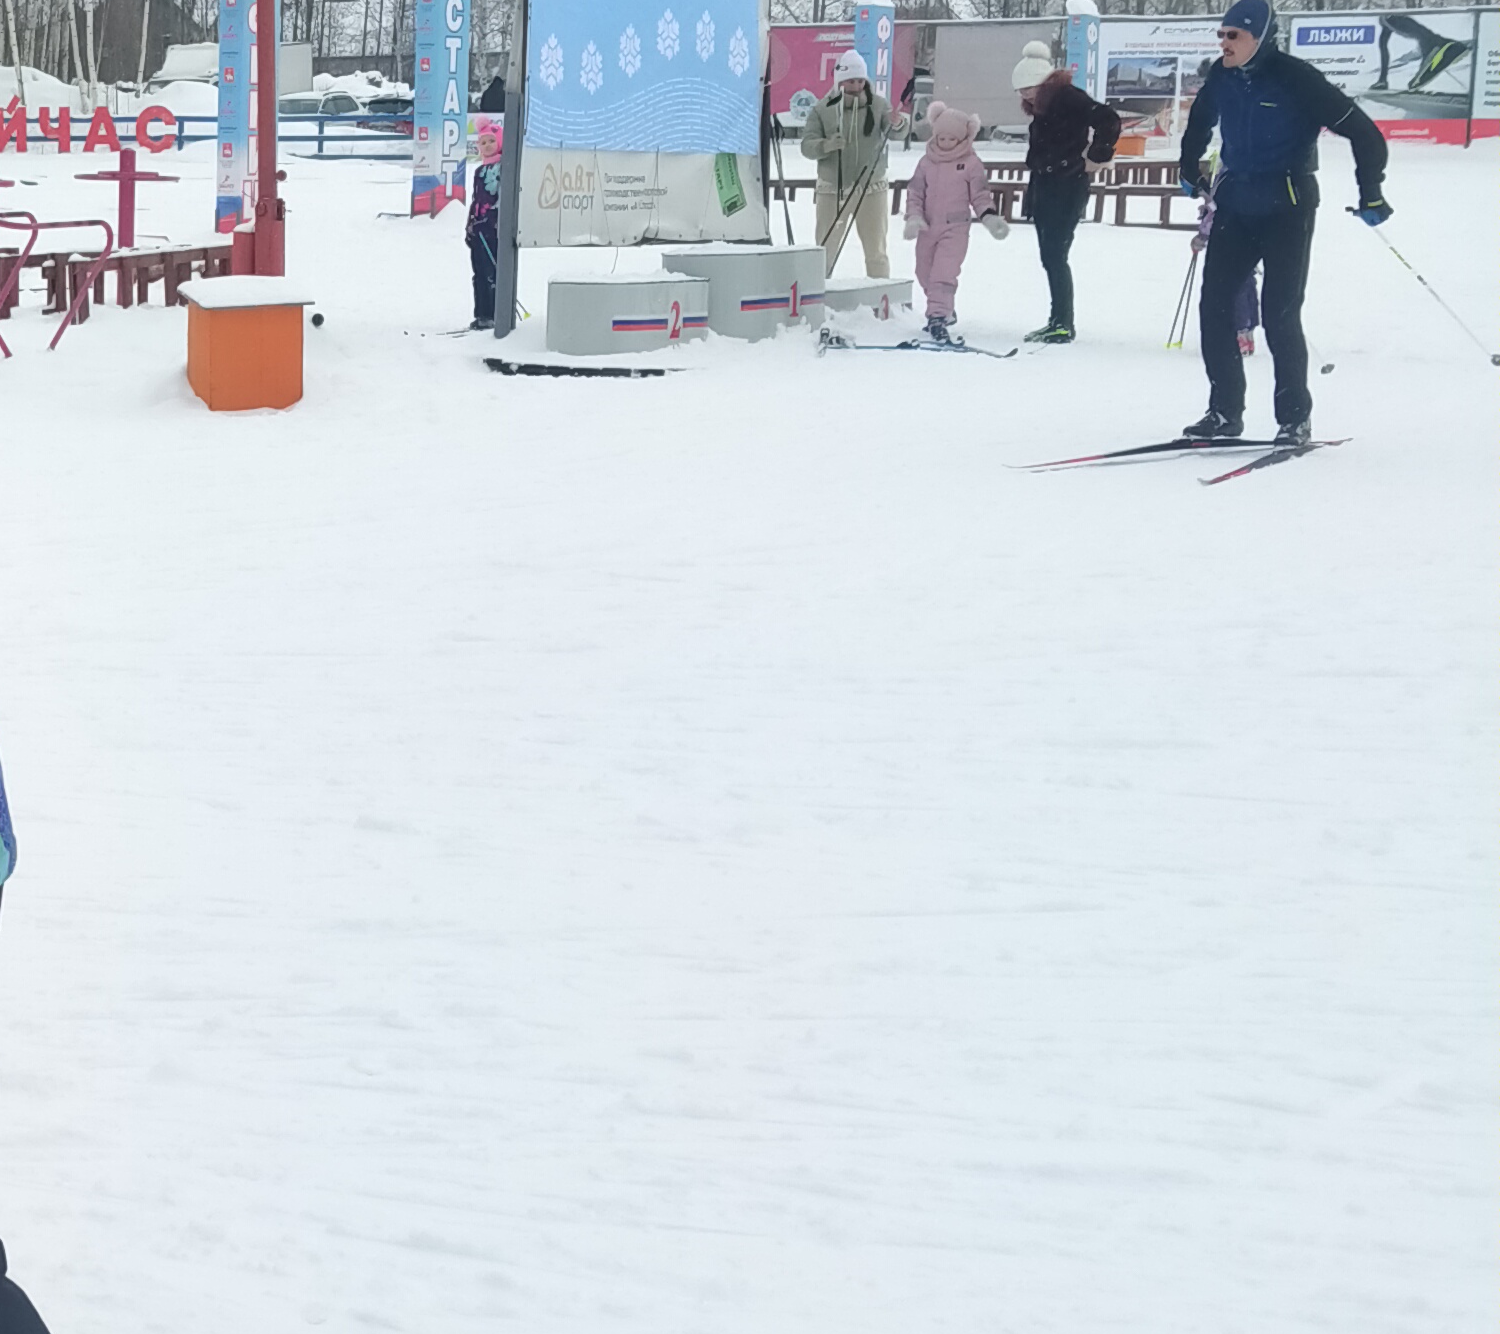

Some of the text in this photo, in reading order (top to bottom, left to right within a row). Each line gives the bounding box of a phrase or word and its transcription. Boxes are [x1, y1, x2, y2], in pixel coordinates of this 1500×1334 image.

[1307, 28, 1366, 44] ЛЫЖИ
[789, 280, 799, 318] 1
[669, 300, 682, 340] 2
